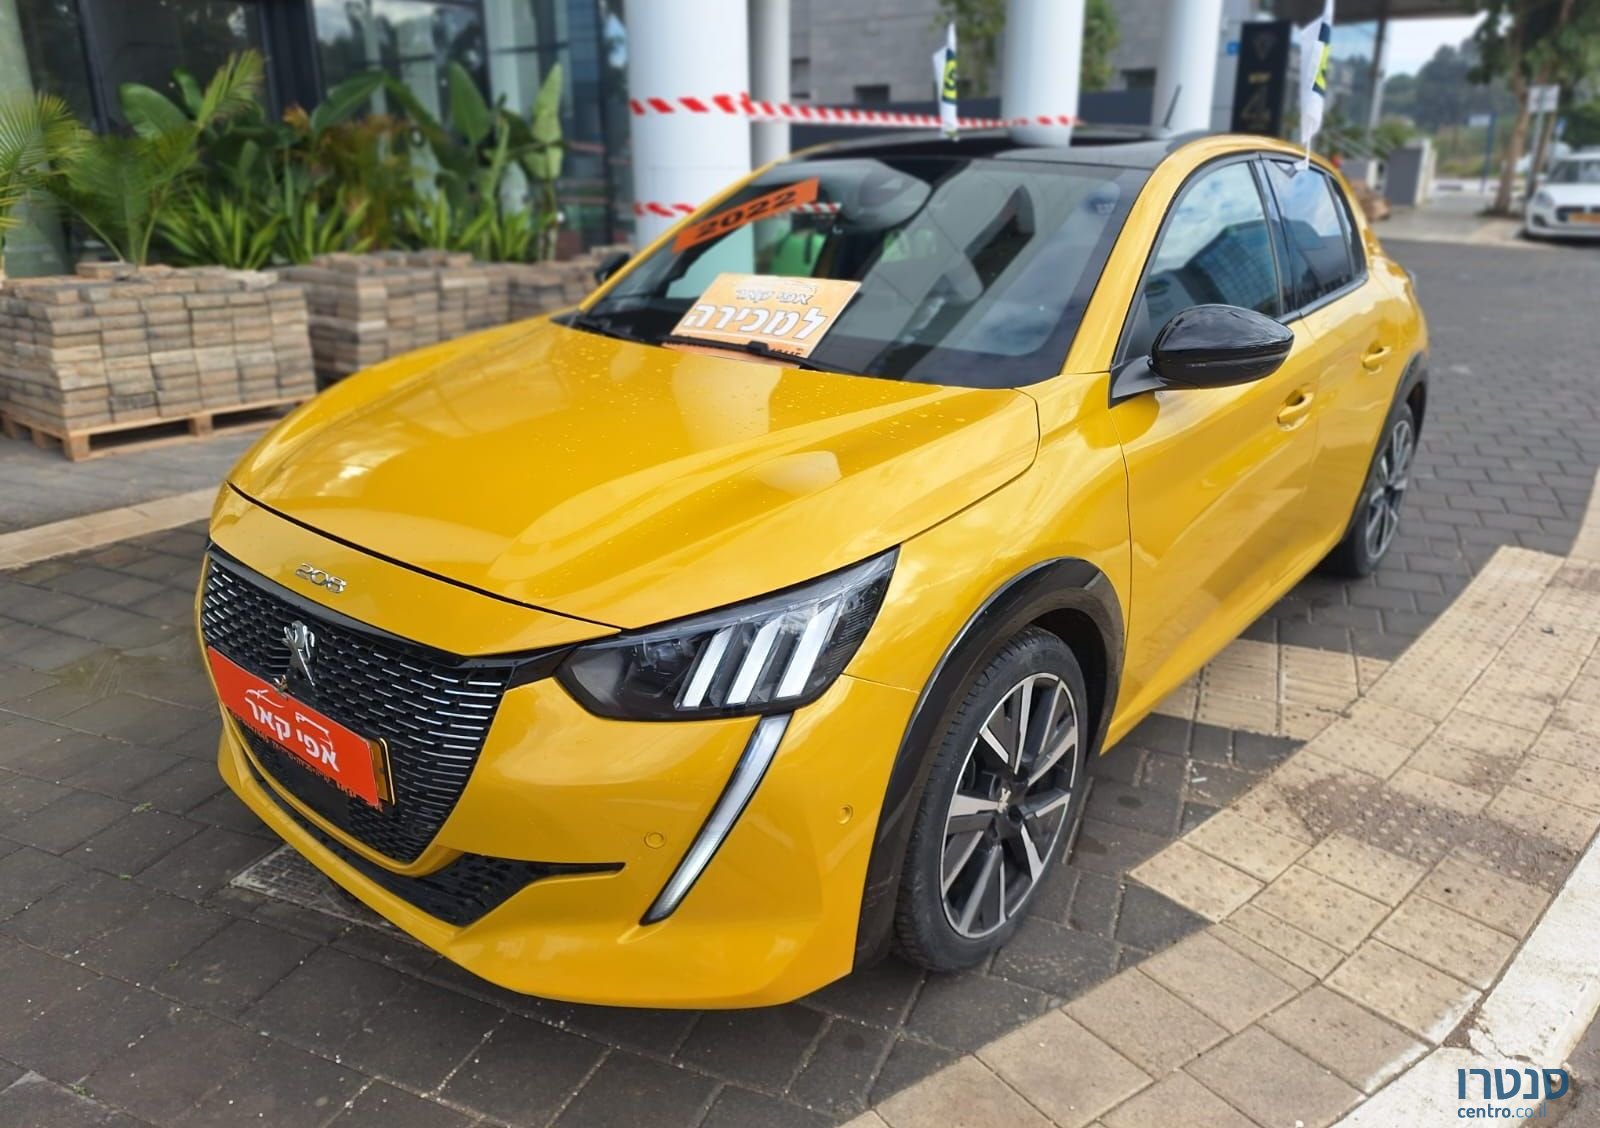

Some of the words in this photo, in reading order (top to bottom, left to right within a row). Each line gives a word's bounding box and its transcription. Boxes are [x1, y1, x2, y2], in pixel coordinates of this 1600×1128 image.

[694, 190, 797, 239] 2022
[683, 304, 829, 341] למכירה
[296, 563, 347, 593] 208
[244, 697, 291, 741] קאר
[296, 729, 340, 772] אפי
